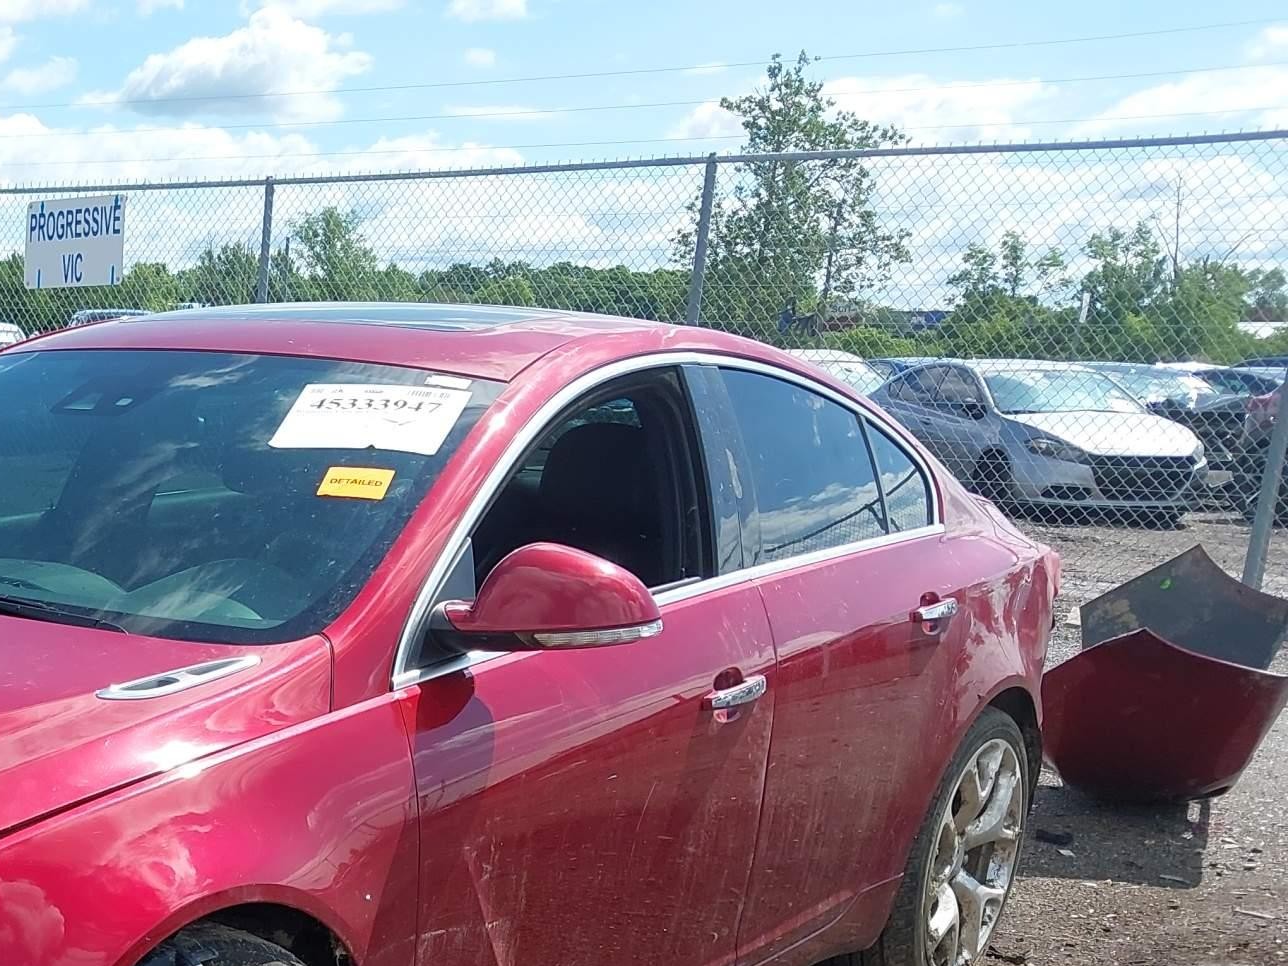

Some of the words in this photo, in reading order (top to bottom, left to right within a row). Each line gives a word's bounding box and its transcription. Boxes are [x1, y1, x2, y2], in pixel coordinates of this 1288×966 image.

[29, 205, 121, 243] PROGRESSIVE
[62, 253, 83, 284] VIC
[309, 397, 444, 414] 45333947
[329, 478, 383, 487] DETAILED
